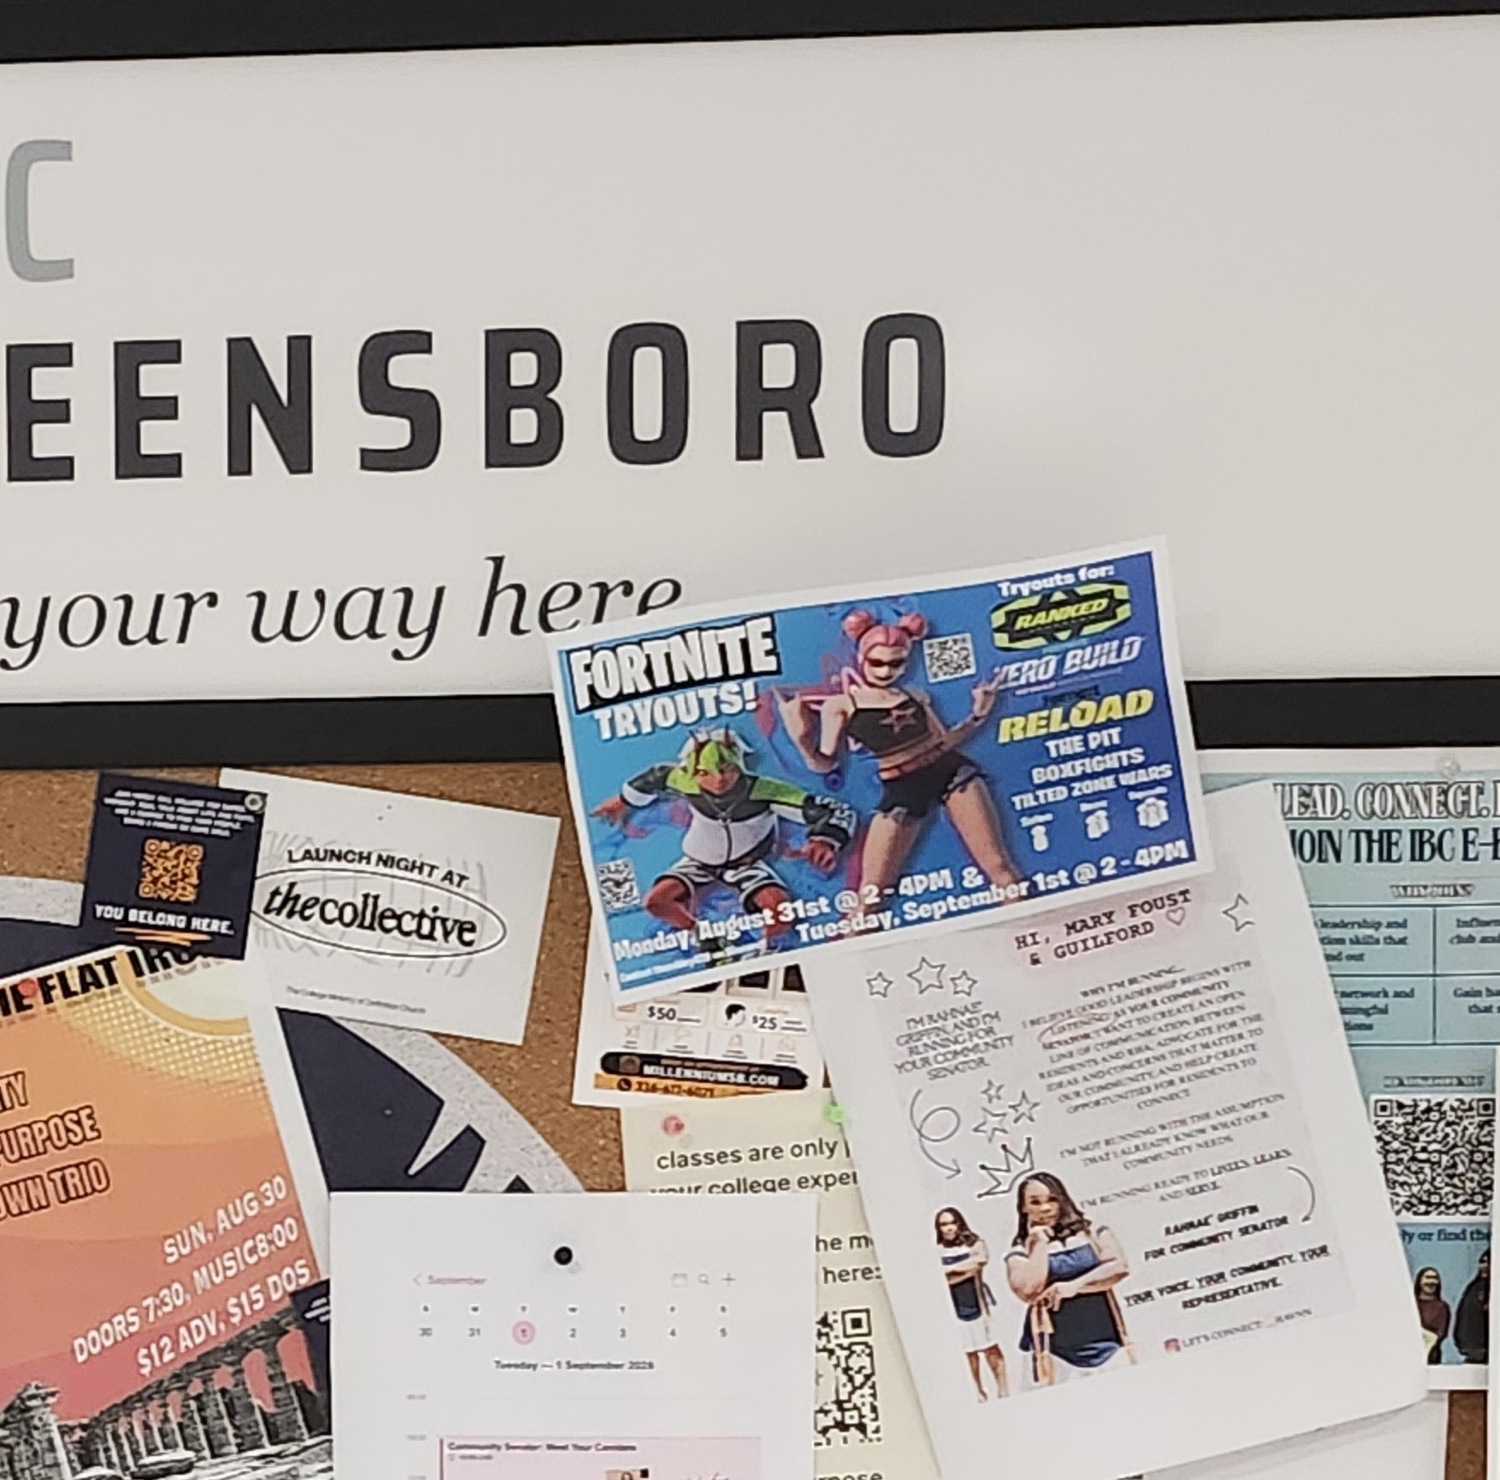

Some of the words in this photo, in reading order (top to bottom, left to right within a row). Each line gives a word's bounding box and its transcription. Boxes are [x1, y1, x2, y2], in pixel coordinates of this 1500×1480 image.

[248, 584, 447, 661] way
[571, 617, 779, 708] FORTNITE
[594, 683, 757, 741] TRYOUTS!
[999, 689, 1155, 744] RELOAD
[1355, 782, 1490, 819] CONNECT.
[288, 848, 371, 868] LAUNCH
[375, 855, 430, 878] NIGHT
[439, 869, 469, 889] AT
[1349, 829, 1402, 863] THE
[1409, 828, 1455, 862] IBC
[94, 905, 124, 921] YOU
[128, 908, 186, 929] BELONG
[191, 915, 235, 934] HERE.
[262, 882, 477, 948] thecollective
[796, 907, 902, 945] Tuesday,
[903, 879, 1031, 923] September
[1031, 867, 1070, 894] 1st
[1066, 911, 1120, 936] MARY
[1128, 889, 1192, 916] FOUST
[1053, 921, 1154, 960] GUILFORD
[42, 959, 121, 1007] FLAT
[656, 1145, 740, 1171] classes
[748, 1145, 782, 1164] are
[786, 1138, 839, 1165] only
[50, 1159, 109, 1207] TRIO
[163, 1222, 212, 1265] SUN,
[214, 1191, 261, 1236] AUG
[262, 1175, 288, 1210] 30
